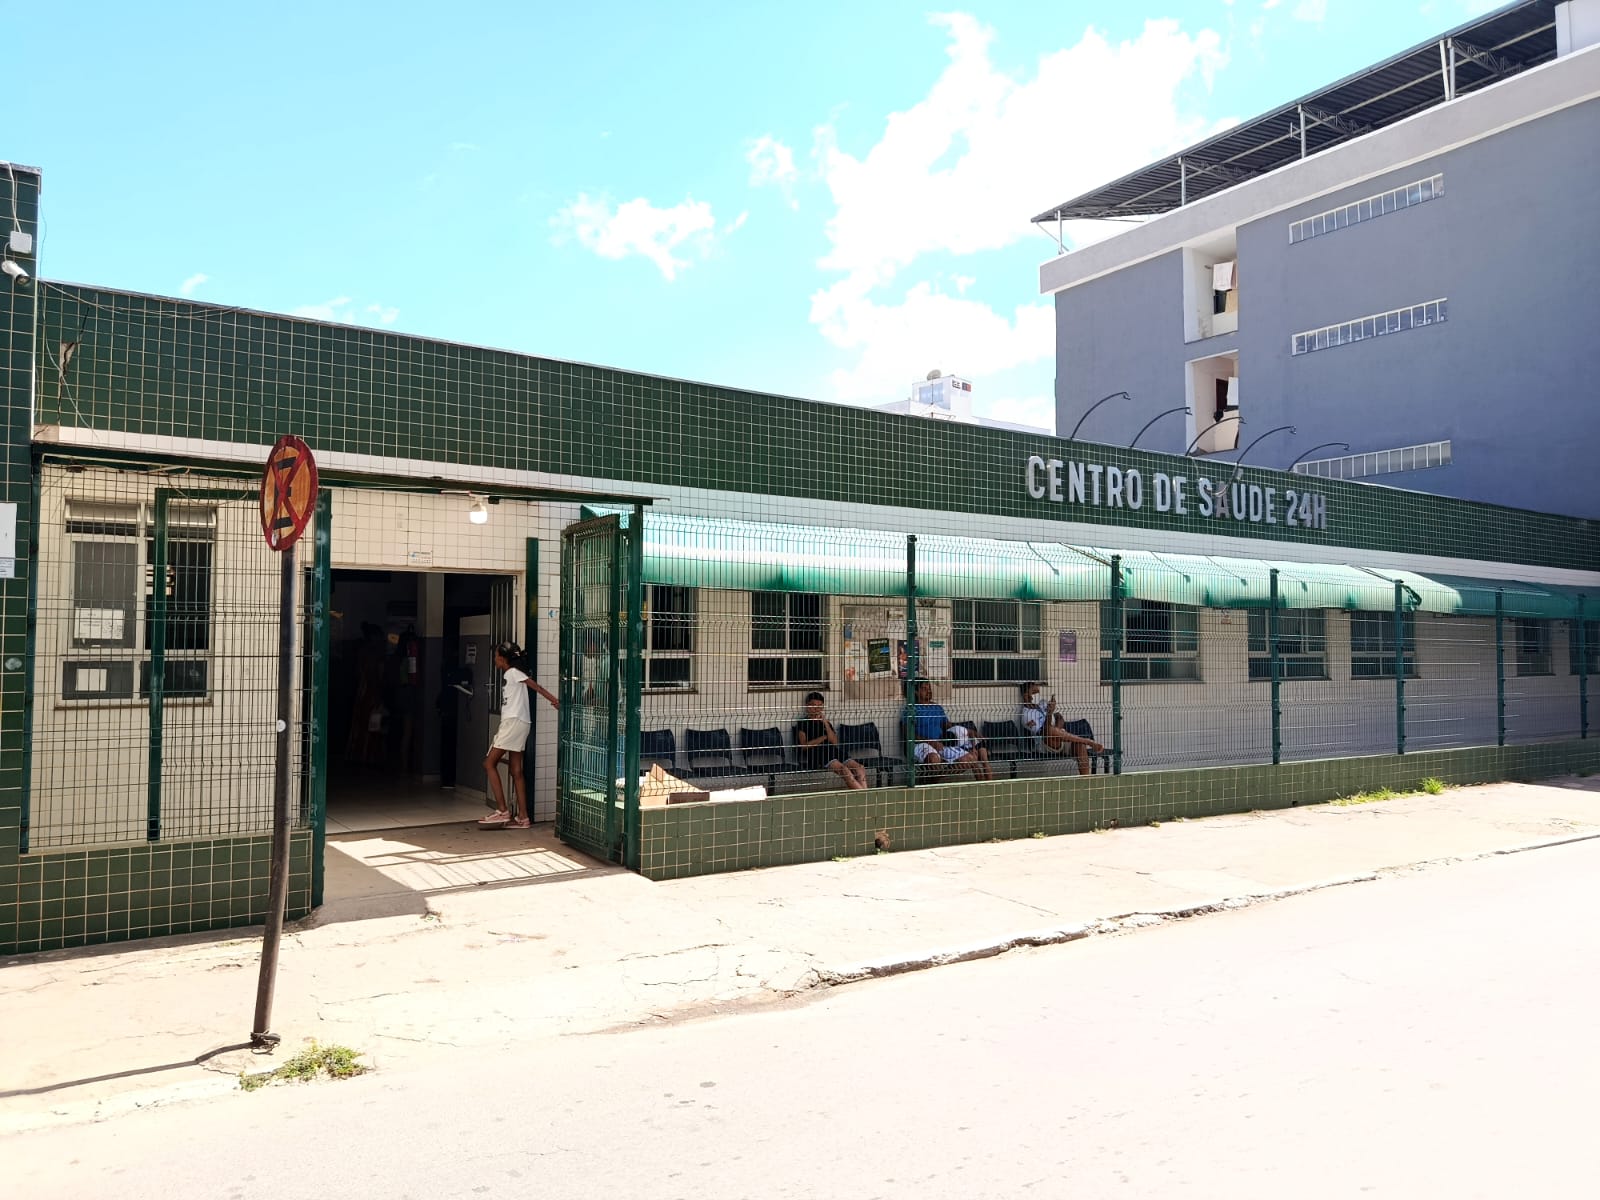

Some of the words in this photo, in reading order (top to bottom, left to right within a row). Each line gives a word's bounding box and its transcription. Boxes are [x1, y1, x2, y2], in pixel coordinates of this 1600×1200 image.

[1025, 455, 1143, 510] CENTRO
[1153, 472, 1188, 516] DE
[1285, 489, 1327, 530] 24H
